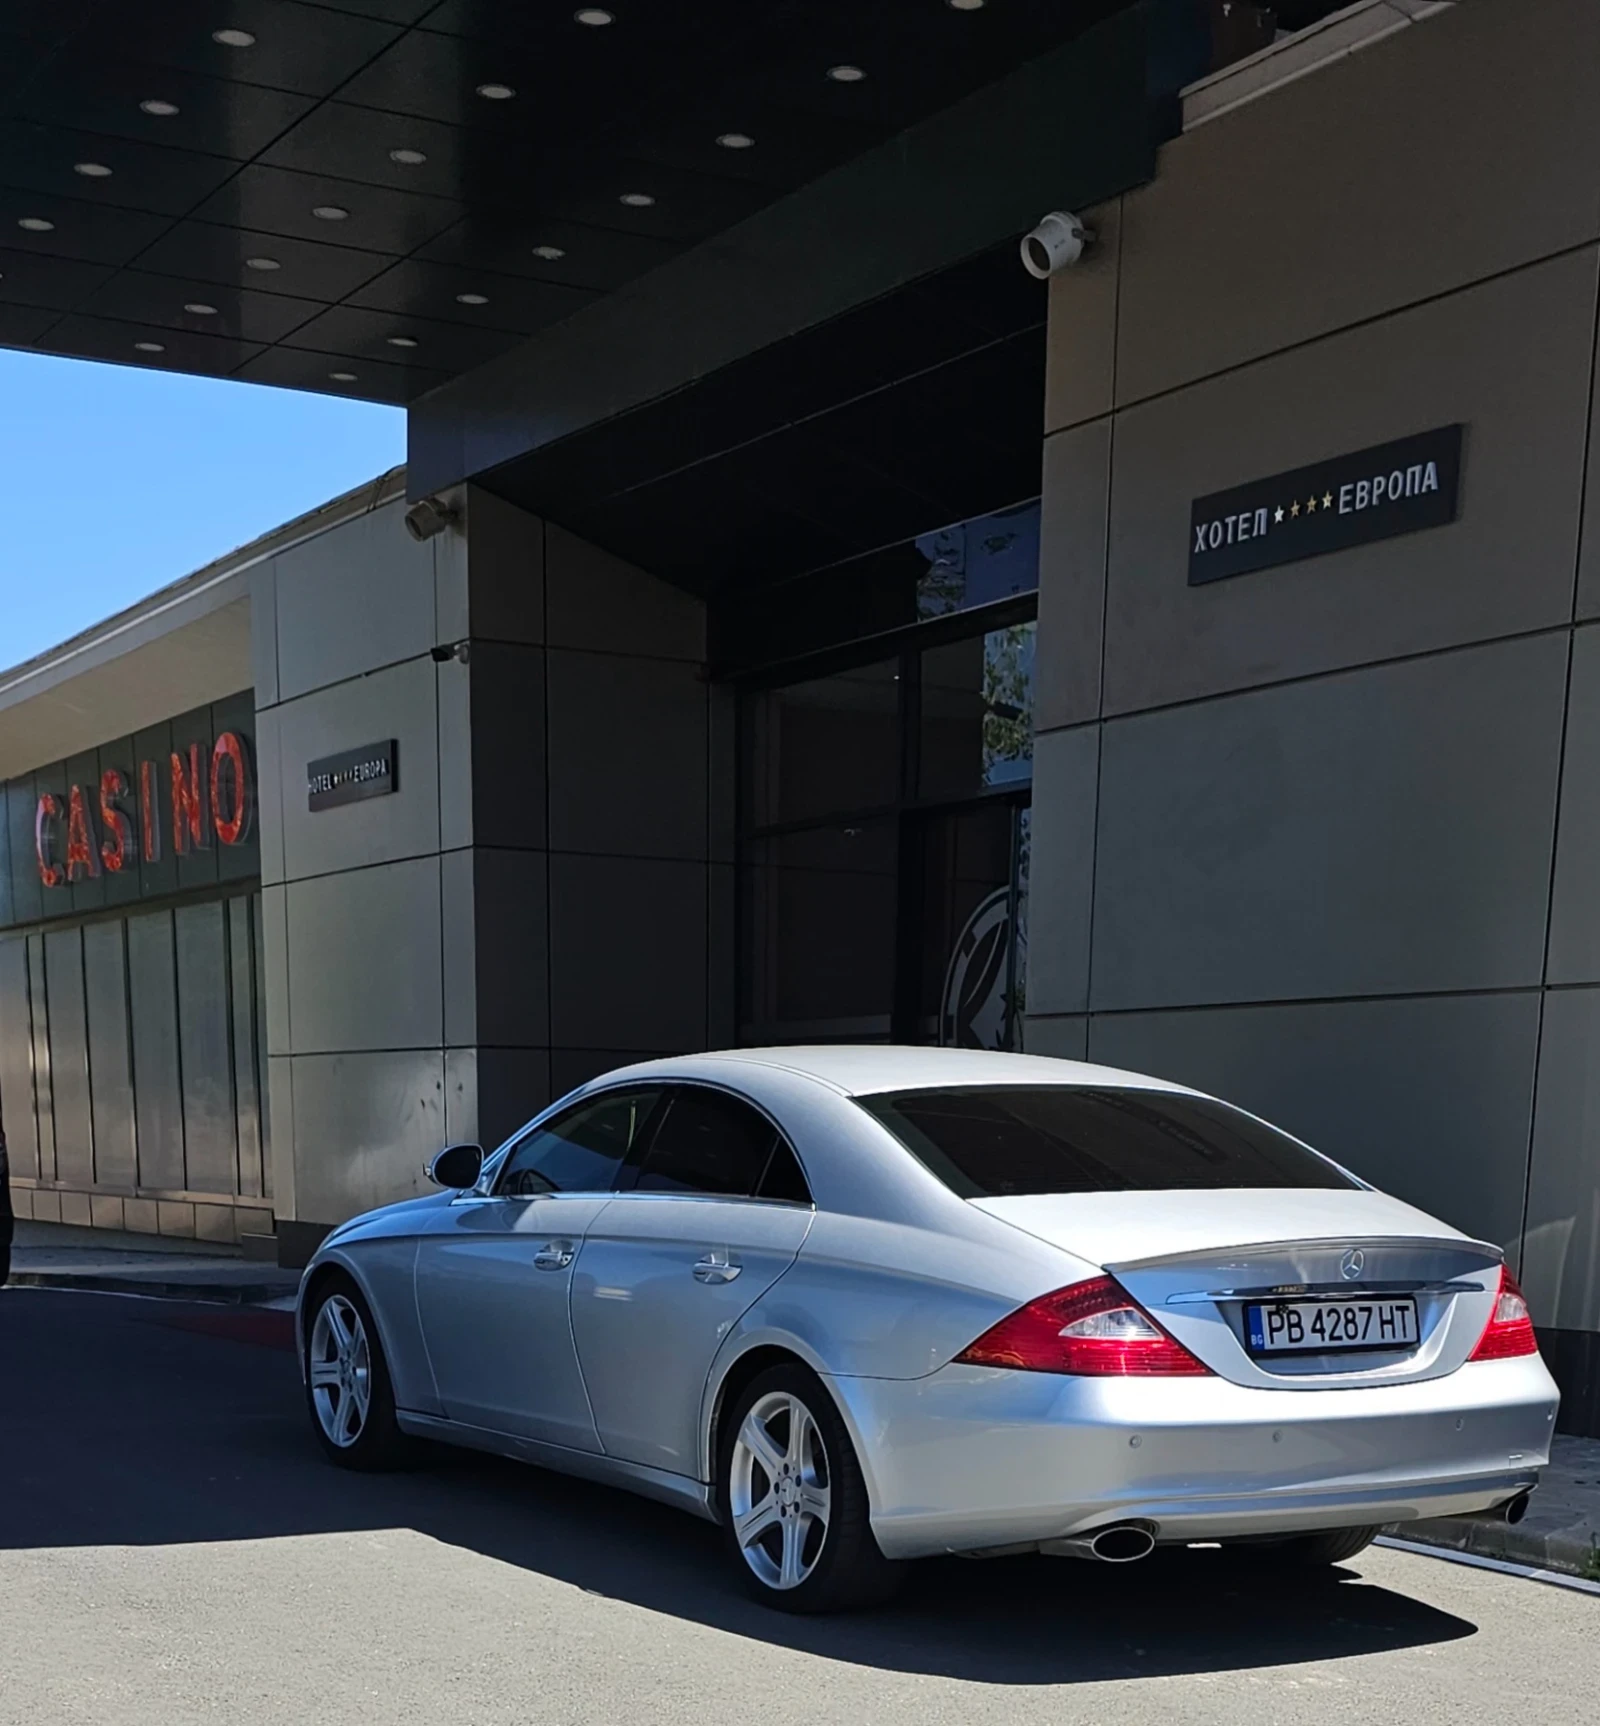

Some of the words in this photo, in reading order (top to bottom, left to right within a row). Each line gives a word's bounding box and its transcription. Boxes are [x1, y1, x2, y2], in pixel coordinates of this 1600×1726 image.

[1194, 508, 1268, 553] ХОТЕЛ
[1338, 461, 1439, 514] ЕВРОПА
[354, 758, 386, 782] EUROPA
[35, 732, 245, 888] CASINO
[1251, 1334, 1264, 1345] BG
[1311, 1306, 1373, 1342] 4287
[1378, 1305, 1410, 1339] HT
